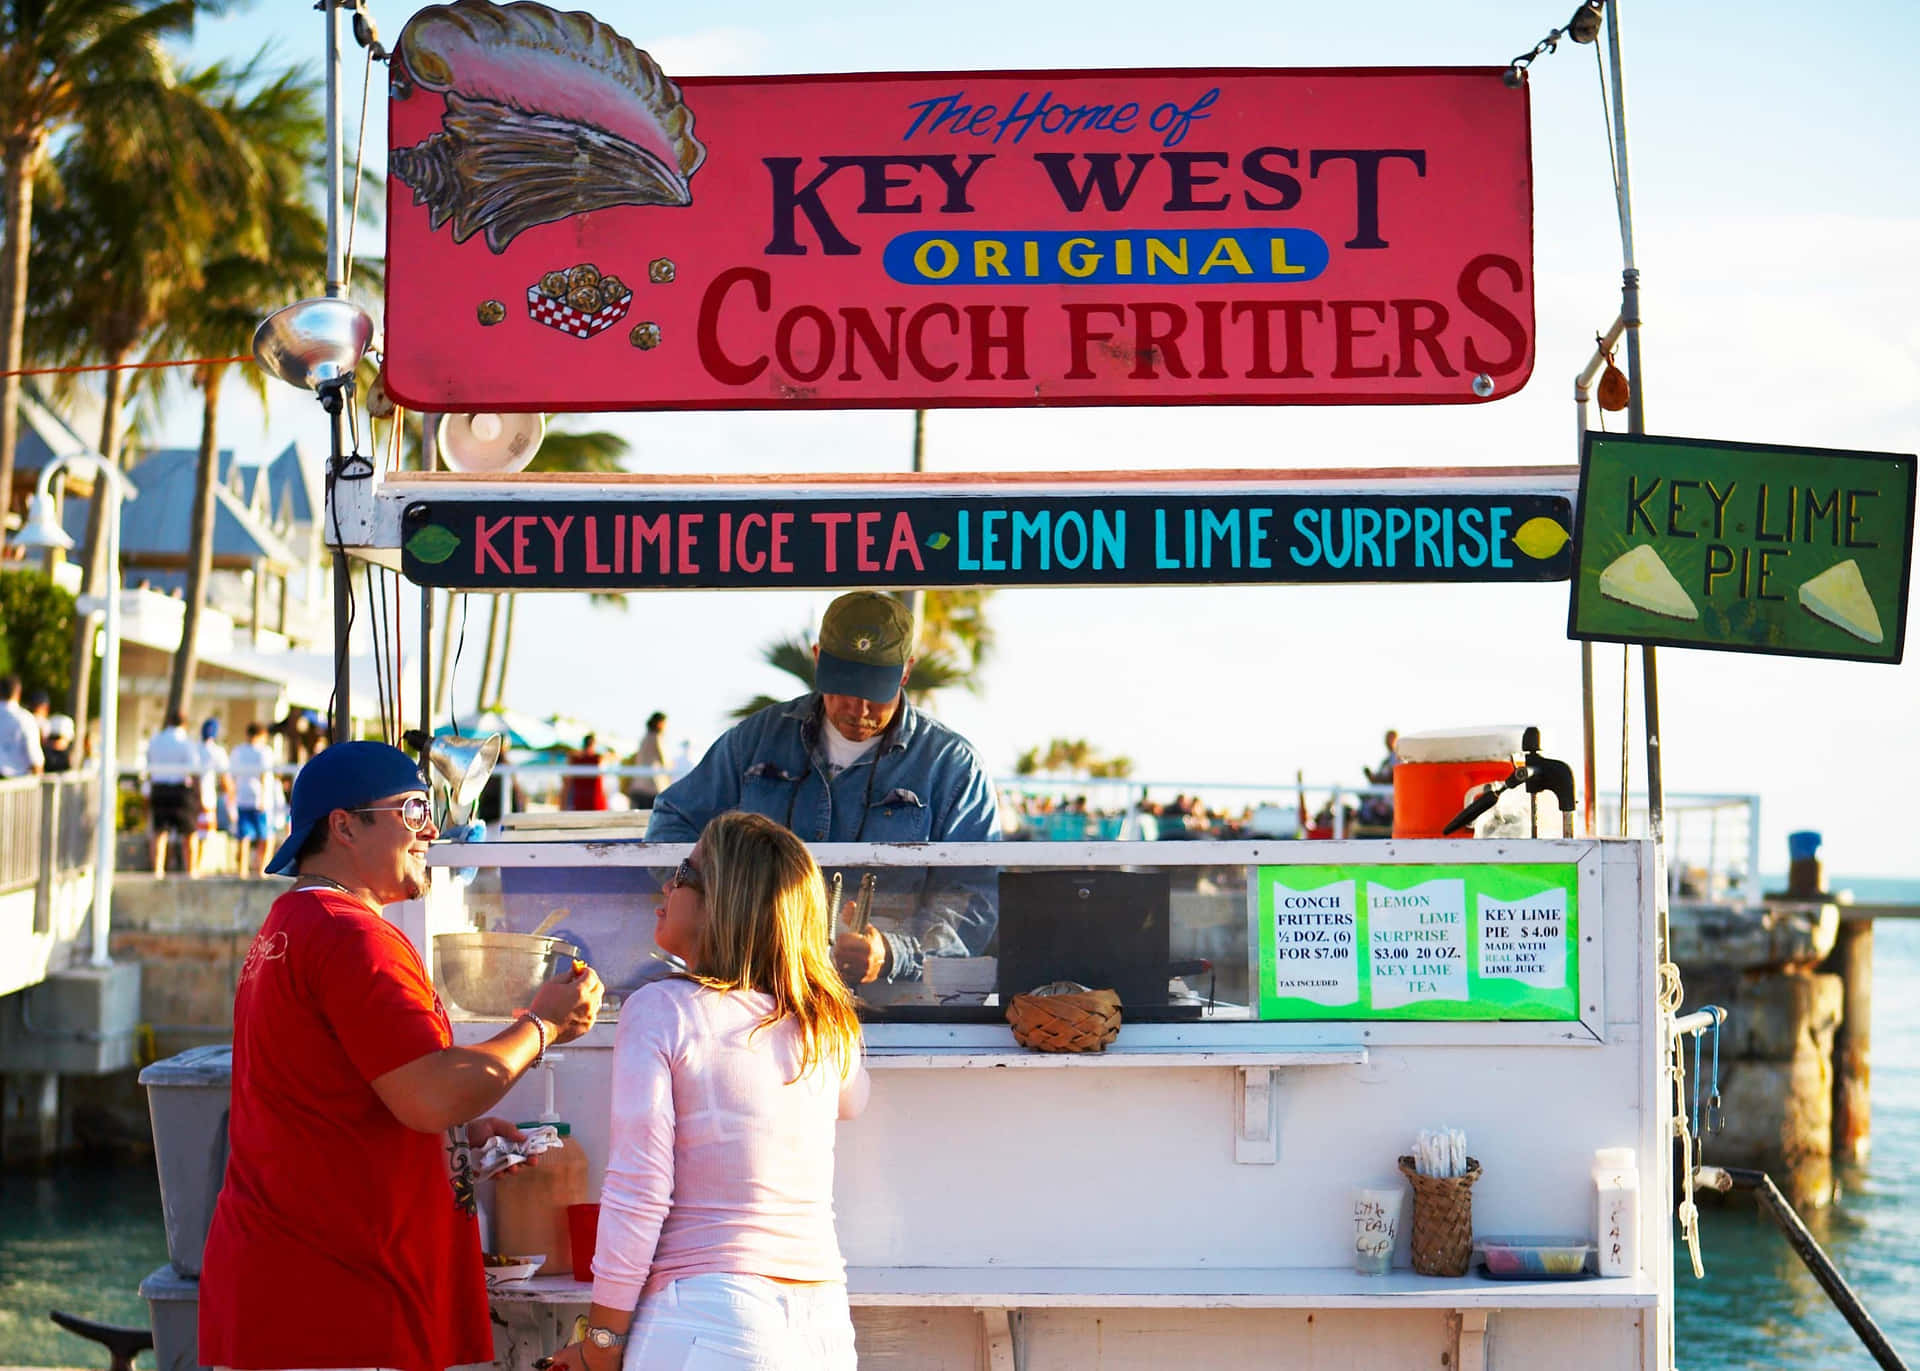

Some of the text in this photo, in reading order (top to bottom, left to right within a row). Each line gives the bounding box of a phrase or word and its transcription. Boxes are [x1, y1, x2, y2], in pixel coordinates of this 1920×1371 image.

[905, 87, 1222, 147] The Home of
[761, 147, 1427, 257] KEY WEST
[912, 235, 1307, 280] ORIGINAL
[696, 254, 1526, 386] CONCH FRITTERS
[1627, 475, 1881, 549] KEY LIME
[474, 511, 925, 575] KEY LIME ICE TEA
[957, 506, 1514, 571] LEMON LIME SURPRISE
[1704, 543, 1791, 601] PIE
[1284, 896, 1340, 909] CONCH
[1373, 895, 1430, 908] LEMON
[1278, 913, 1353, 926] FRITTERS
[1420, 912, 1459, 924] LIME
[1485, 908, 1561, 921] KEY LIME
[1294, 931, 1330, 943] DOZ.
[1333, 931, 1351, 944] (6)
[1374, 929, 1449, 943] SURPRISE
[1485, 926, 1509, 938] PIE
[1374, 946, 1461, 960] $3.00 20 OZ.
[1485, 942, 1546, 951] MADE WITH
[1279, 947, 1349, 960] FOR $7.00
[1516, 953, 1537, 962] KEY
[1376, 964, 1452, 976] KEY LIME
[1485, 964, 1545, 974] LIME JUICE
[1280, 979, 1339, 988] TAX INCLUDED
[1407, 980, 1437, 993] TEA
